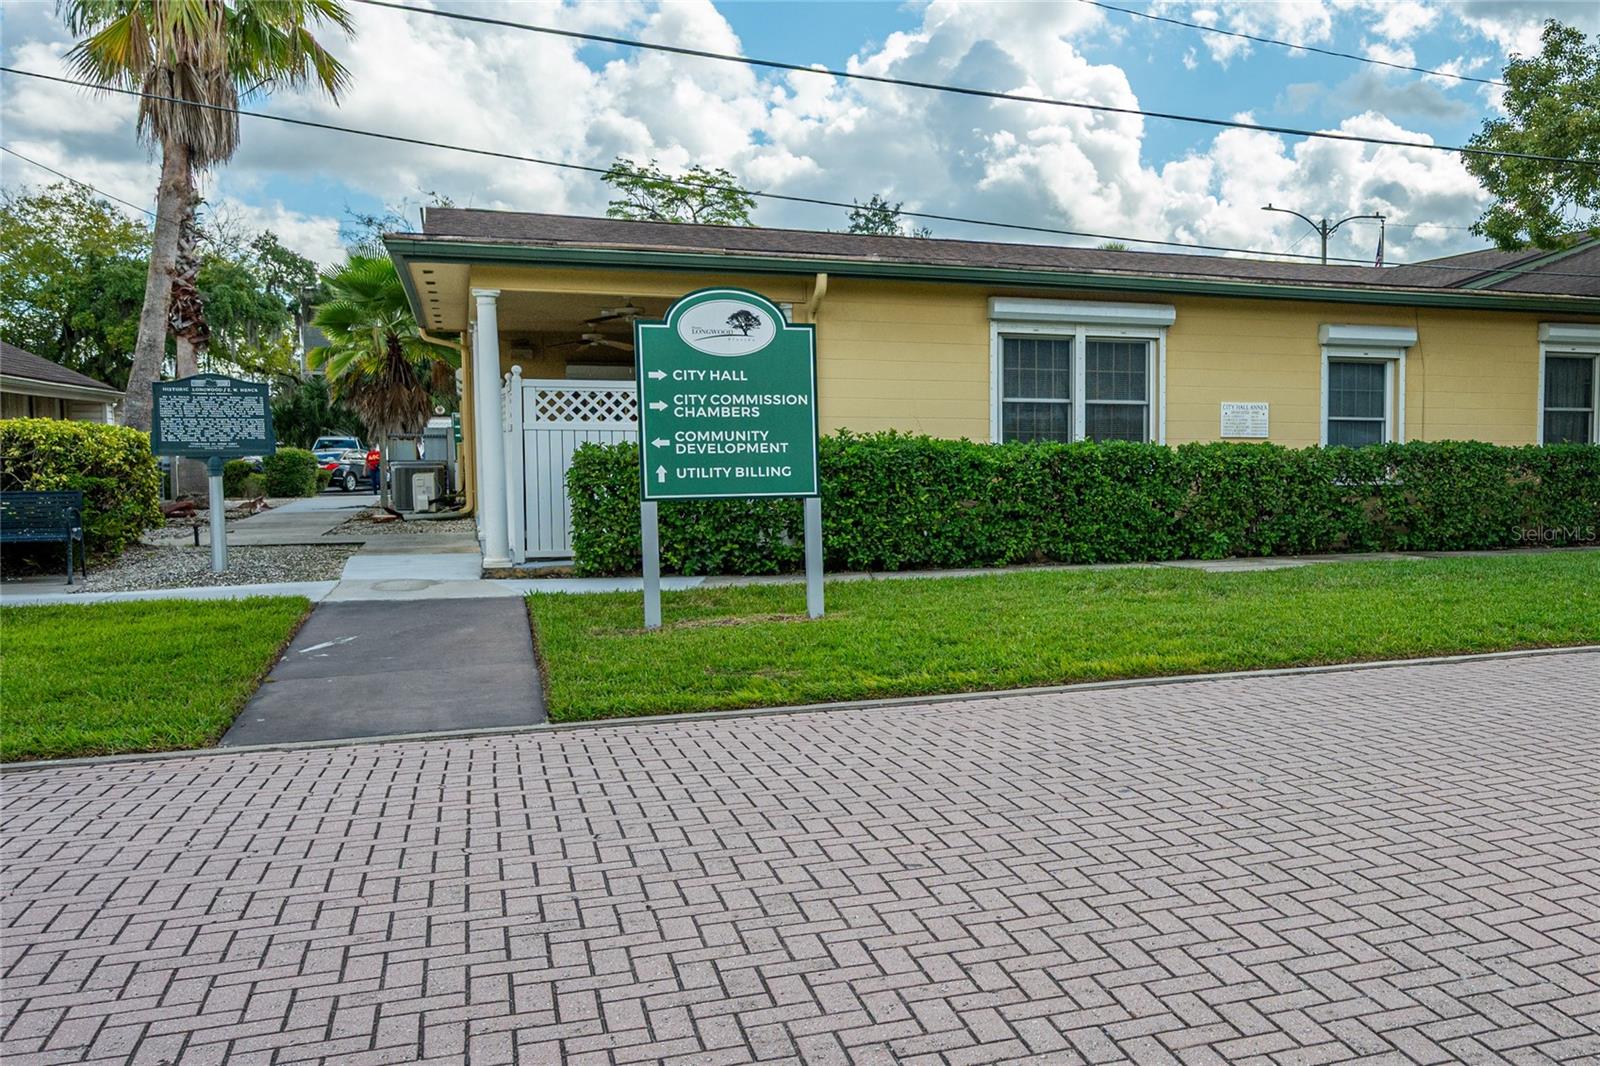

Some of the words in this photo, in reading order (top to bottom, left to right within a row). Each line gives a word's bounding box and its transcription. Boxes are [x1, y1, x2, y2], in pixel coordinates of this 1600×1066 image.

[672, 370, 706, 382] CITY
[710, 370, 748, 381] HALL
[673, 395, 707, 406] CITY
[710, 394, 808, 406] COMMISSION
[673, 406, 760, 418] CHAMBERS
[674, 430, 769, 443] COMMUNITY
[675, 442, 789, 455] DEVELOPMENT
[676, 467, 732, 479] UTILITY
[735, 466, 792, 478] BILLING
